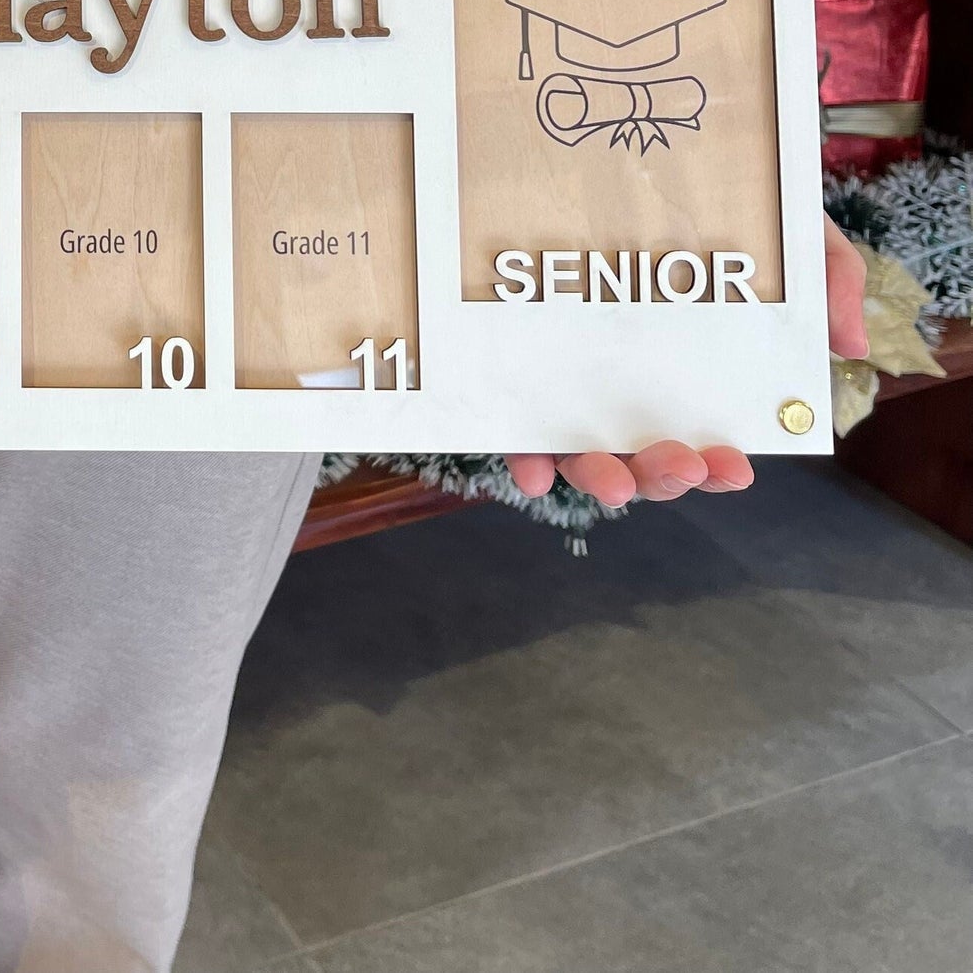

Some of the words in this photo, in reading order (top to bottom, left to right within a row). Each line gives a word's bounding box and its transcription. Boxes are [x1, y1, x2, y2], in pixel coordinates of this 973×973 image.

[59, 228, 127, 255] Grade
[132, 229, 159, 255] 10
[272, 229, 340, 256] Grade
[346, 231, 371, 256] 11
[492, 249, 762, 304] SENIOR
[127, 335, 196, 390] 10
[349, 337, 409, 391] 11
